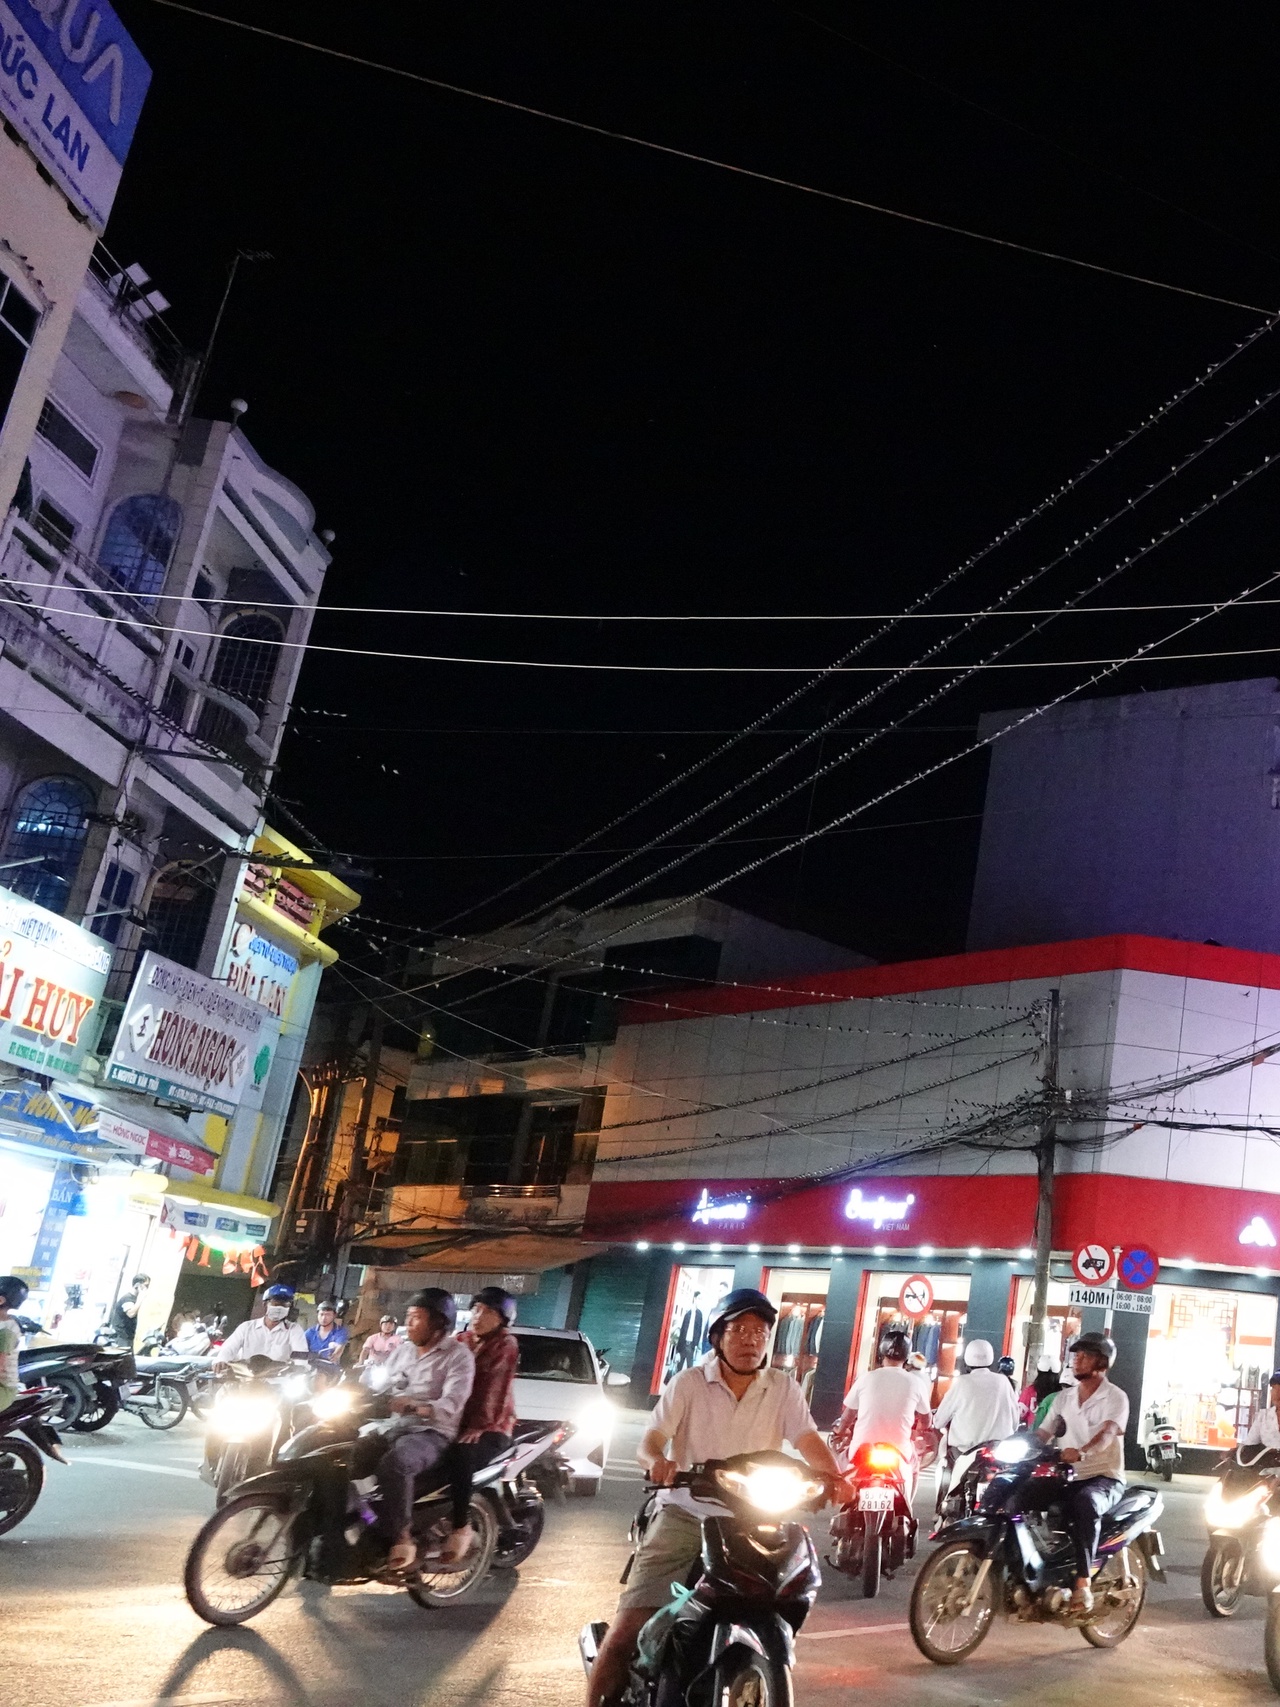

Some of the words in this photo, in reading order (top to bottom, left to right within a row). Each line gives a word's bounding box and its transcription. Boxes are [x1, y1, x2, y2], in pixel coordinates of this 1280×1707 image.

[42, 92, 91, 173] LAN
[21, 976, 95, 1047] HUY
[51, 1186, 73, 1203] BÁN
[1075, 1289, 1105, 1305] 140M
[1116, 1292, 1132, 1301] 06:00
[1136, 1295, 1153, 1304] 08:00
[1115, 1301, 1131, 1310] 16:00
[1136, 1303, 1152, 1312] 18:00
